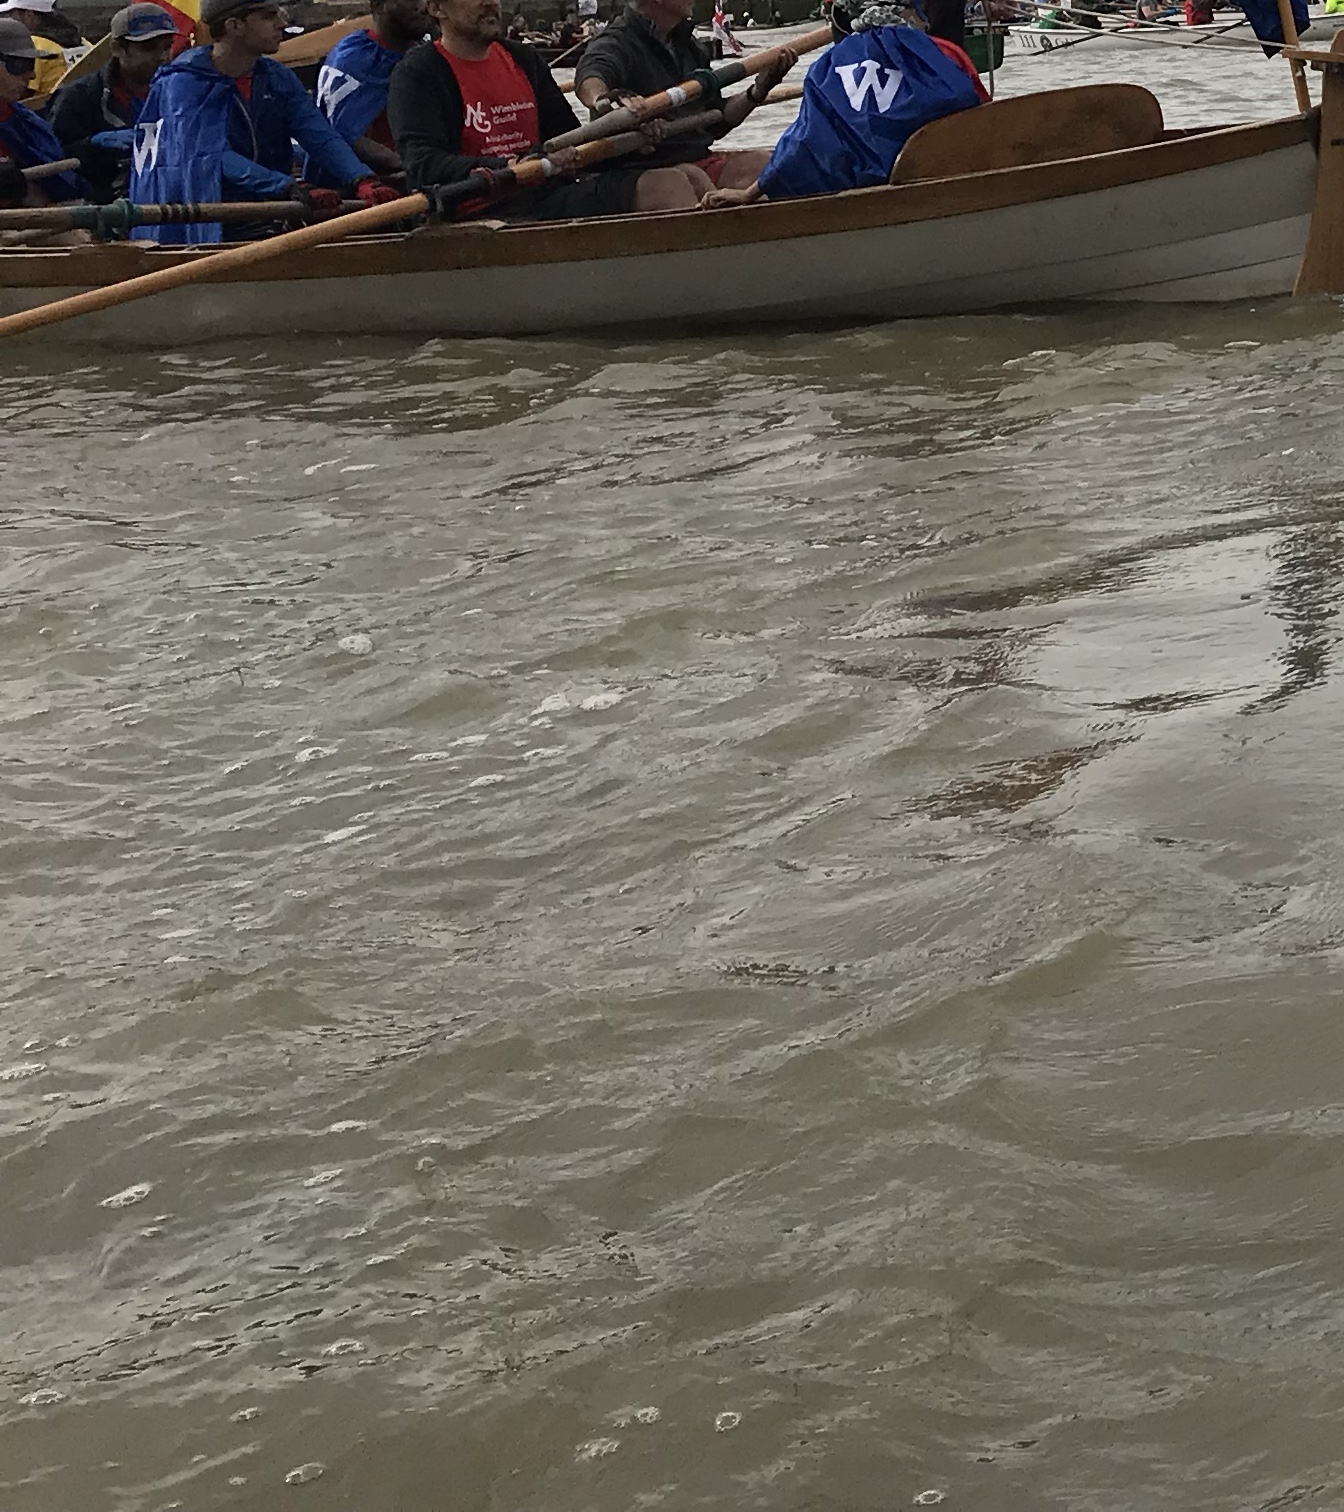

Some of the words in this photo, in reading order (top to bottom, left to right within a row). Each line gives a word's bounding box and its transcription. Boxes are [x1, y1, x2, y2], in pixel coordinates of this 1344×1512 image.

[316, 65, 361, 119] W
[835, 59, 904, 114] W
[133, 118, 164, 178] W
